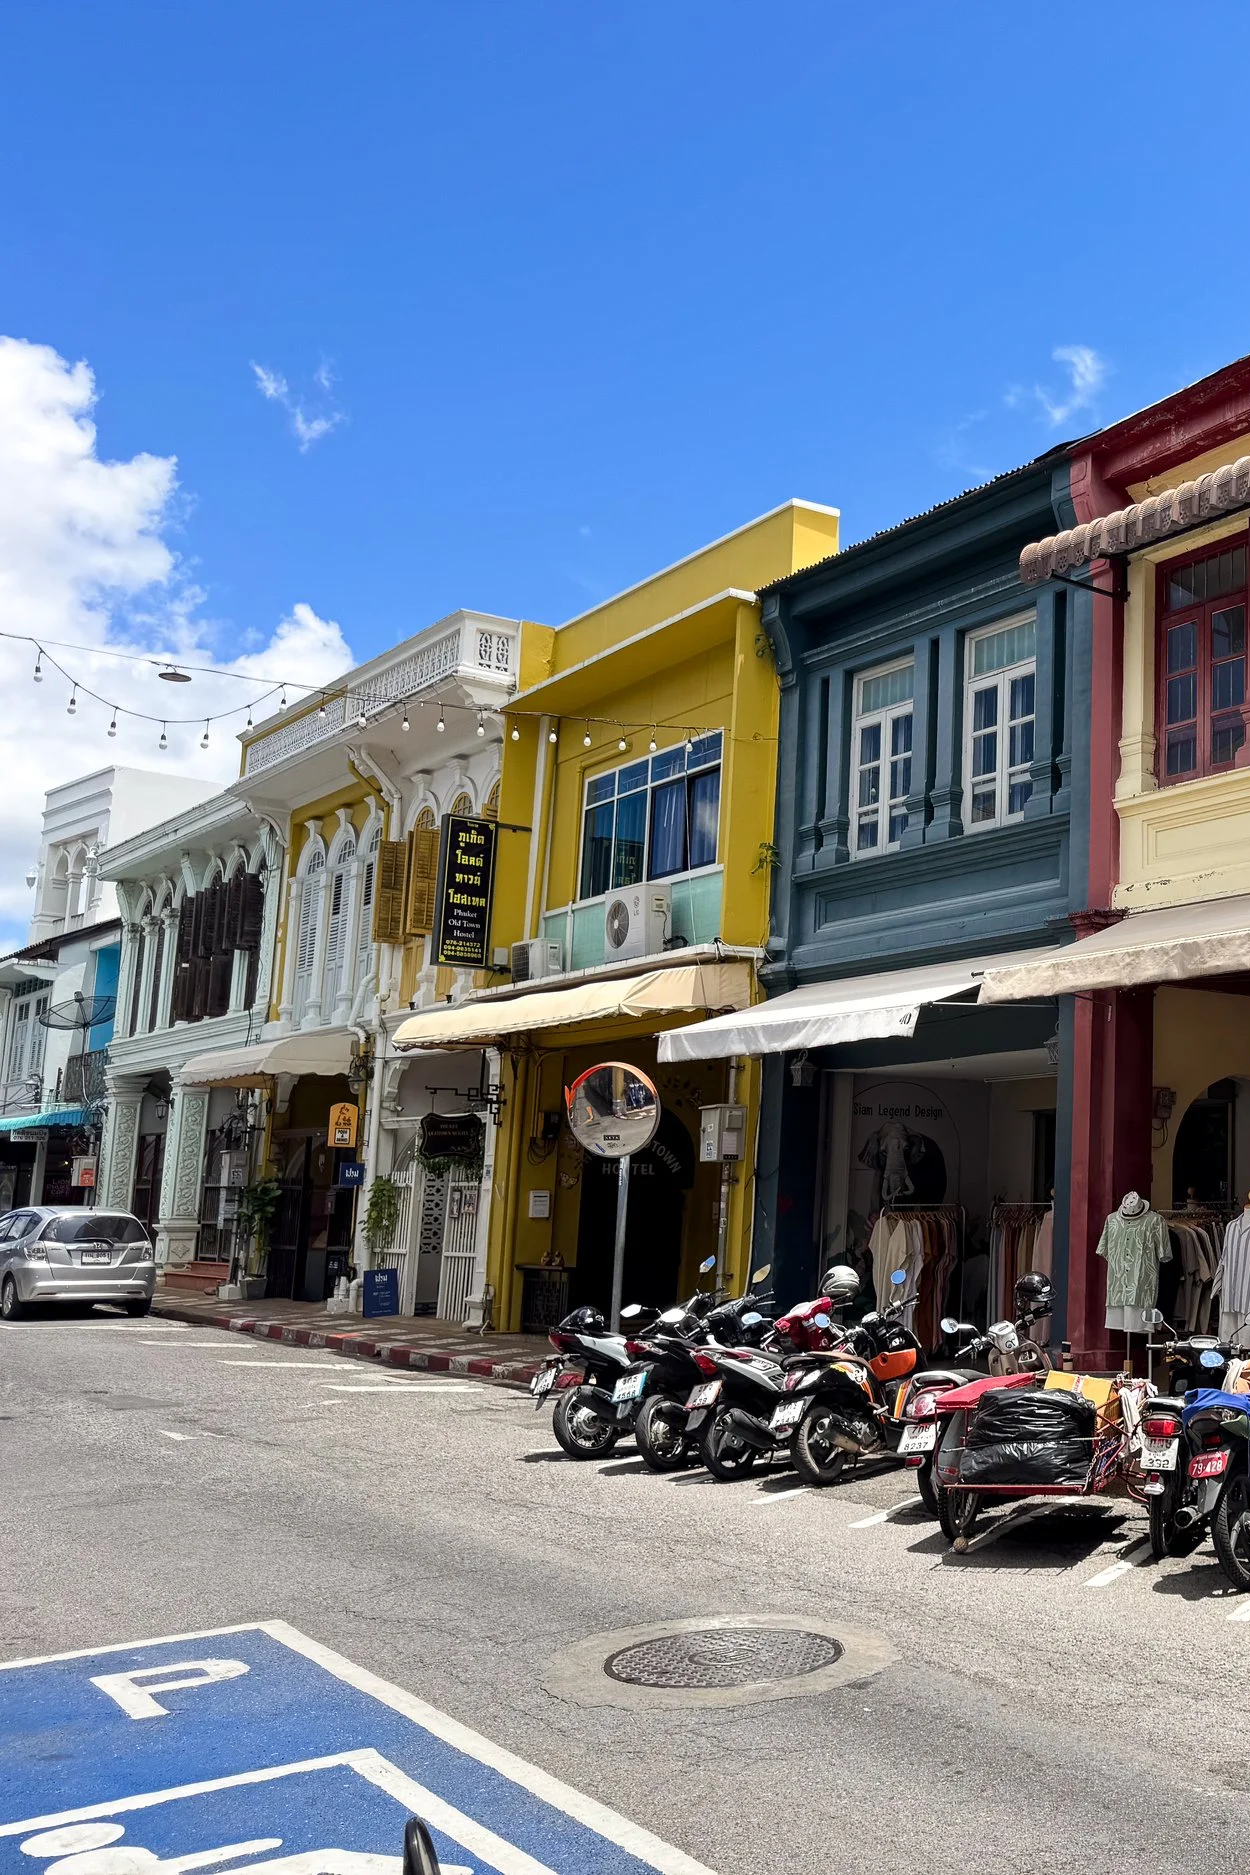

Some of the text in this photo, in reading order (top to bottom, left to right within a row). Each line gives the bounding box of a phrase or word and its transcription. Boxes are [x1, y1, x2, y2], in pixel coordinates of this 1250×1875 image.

[453, 909, 477, 918] Phuket
[448, 919, 481, 929] Old Town
[453, 929, 475, 938] Hostel
[853, 1102, 943, 1120] Siam Legend Design
[602, 1163, 655, 1175] HOTEL
[904, 1441, 928, 1450] 8237
[89, 1658, 251, 1720] P
